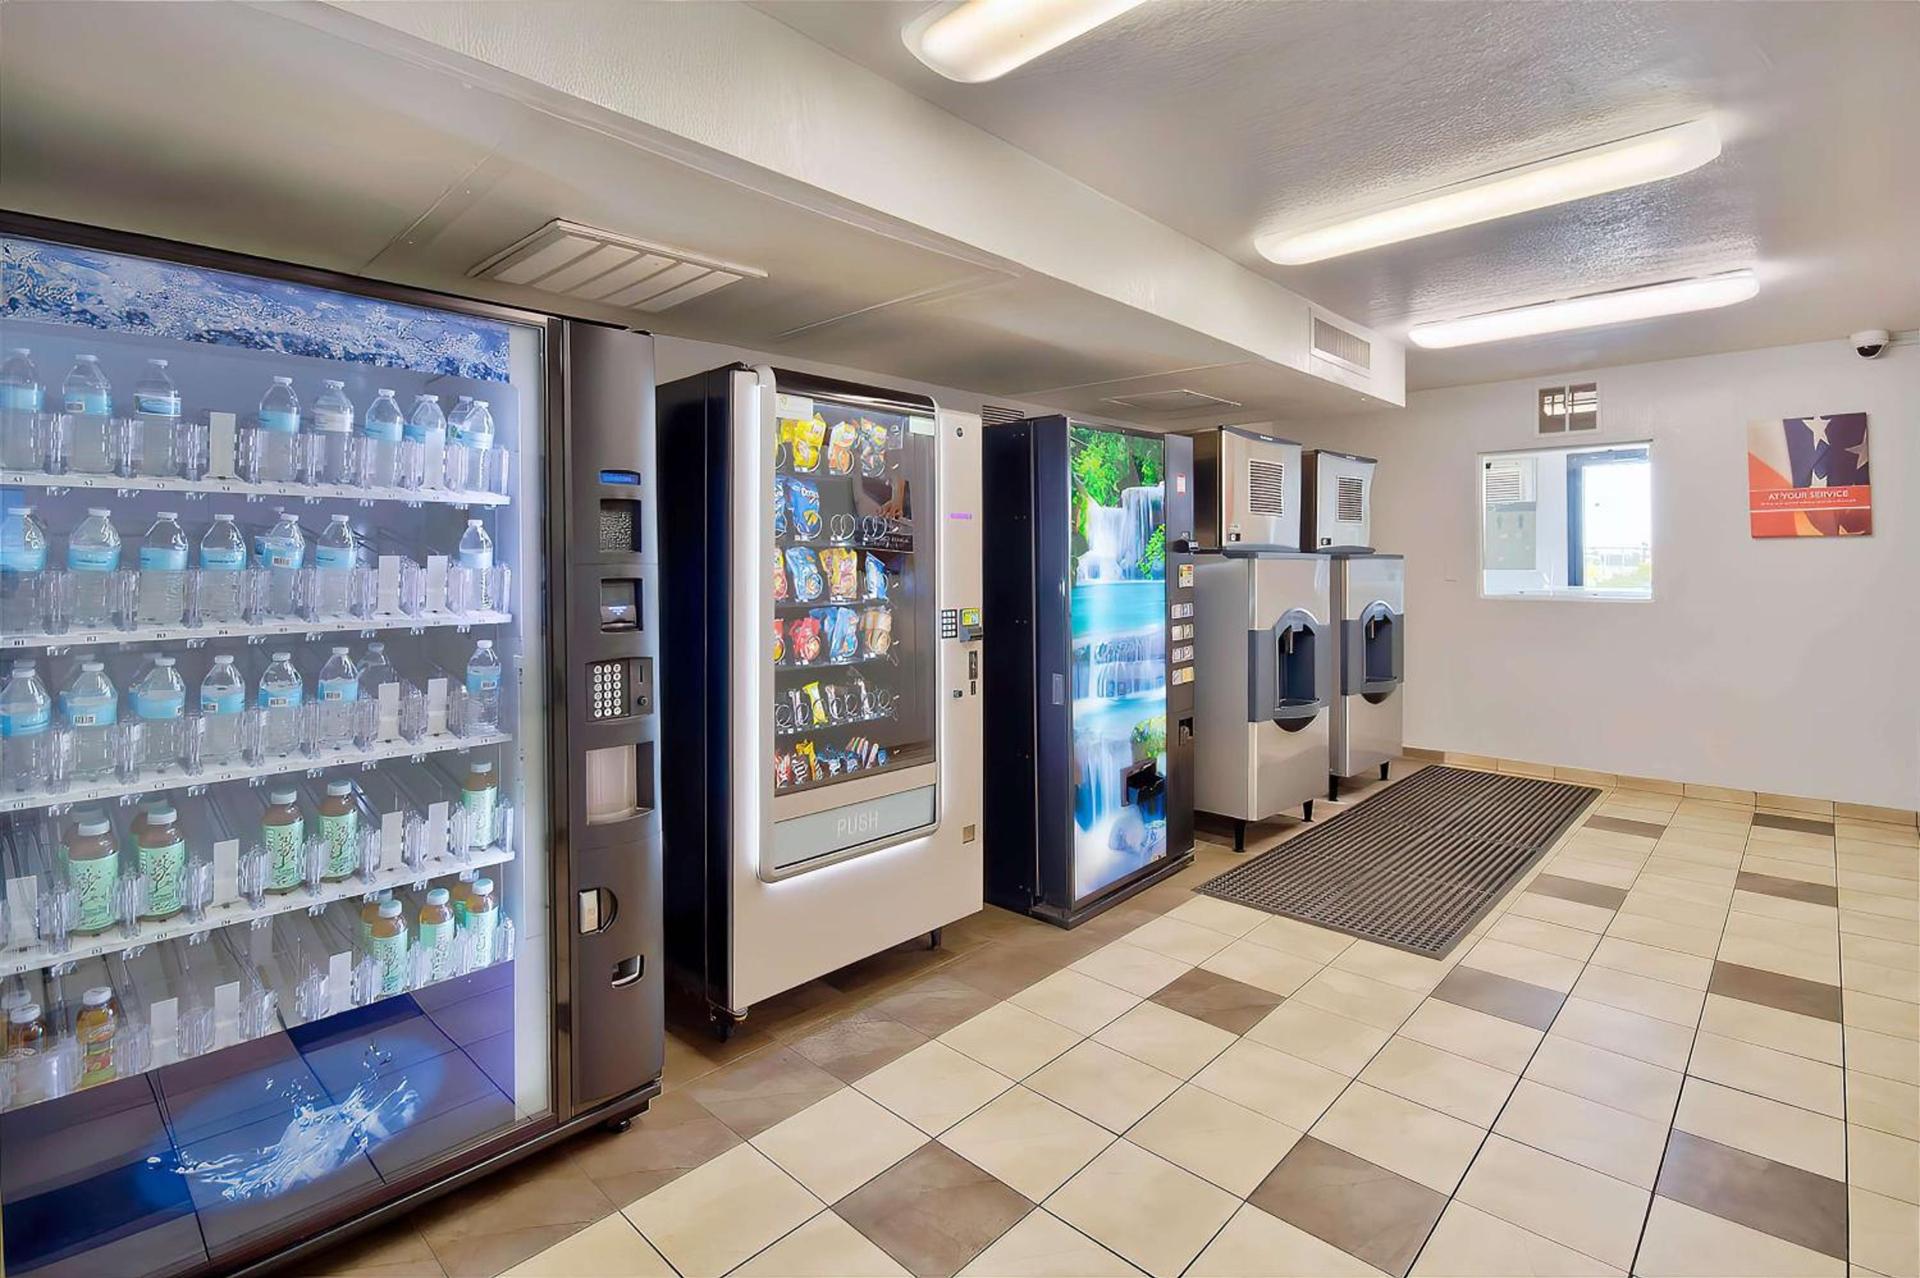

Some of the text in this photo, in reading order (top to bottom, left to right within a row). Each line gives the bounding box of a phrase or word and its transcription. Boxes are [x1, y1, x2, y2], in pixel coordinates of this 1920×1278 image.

[1781, 491, 1807, 499] YOUR
[1810, 490, 1849, 498] SERVICE
[836, 810, 879, 838] PUSH
